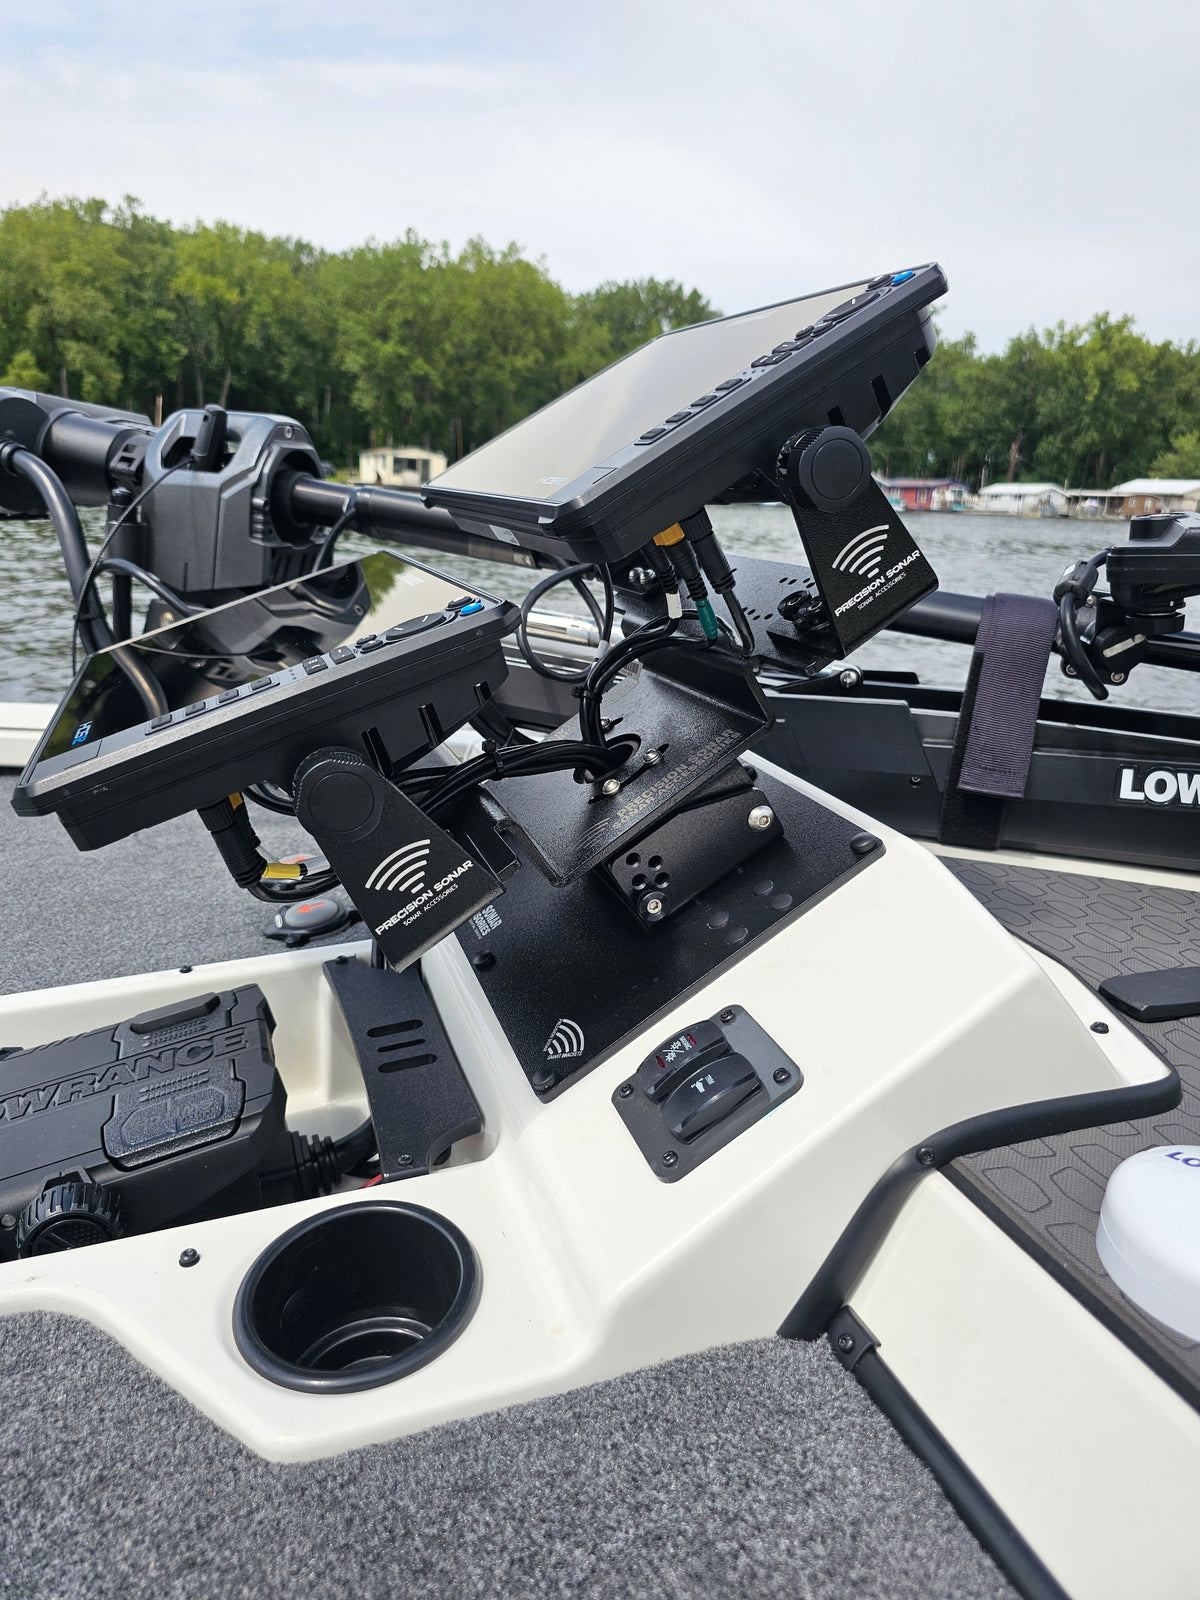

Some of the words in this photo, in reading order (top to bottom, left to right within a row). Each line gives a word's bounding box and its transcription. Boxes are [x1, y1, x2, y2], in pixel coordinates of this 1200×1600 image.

[834, 575, 886, 617] PRECISION
[885, 549, 921, 579] SONAR
[857, 595, 875, 611] SONAR
[875, 571, 907, 598] ACCESSORIES
[612, 794, 656, 830] SONAR
[658, 731, 743, 797] ACCESSORIES
[616, 763, 689, 818] PRECISION
[688, 728, 735, 765] SONAR
[374, 889, 434, 936] PRECISION
[433, 859, 474, 892] SONAR
[403, 910, 423, 927] SONAR
[423, 882, 459, 912] ACCESSORIES
[0, 1026, 249, 1122] WRANCE
